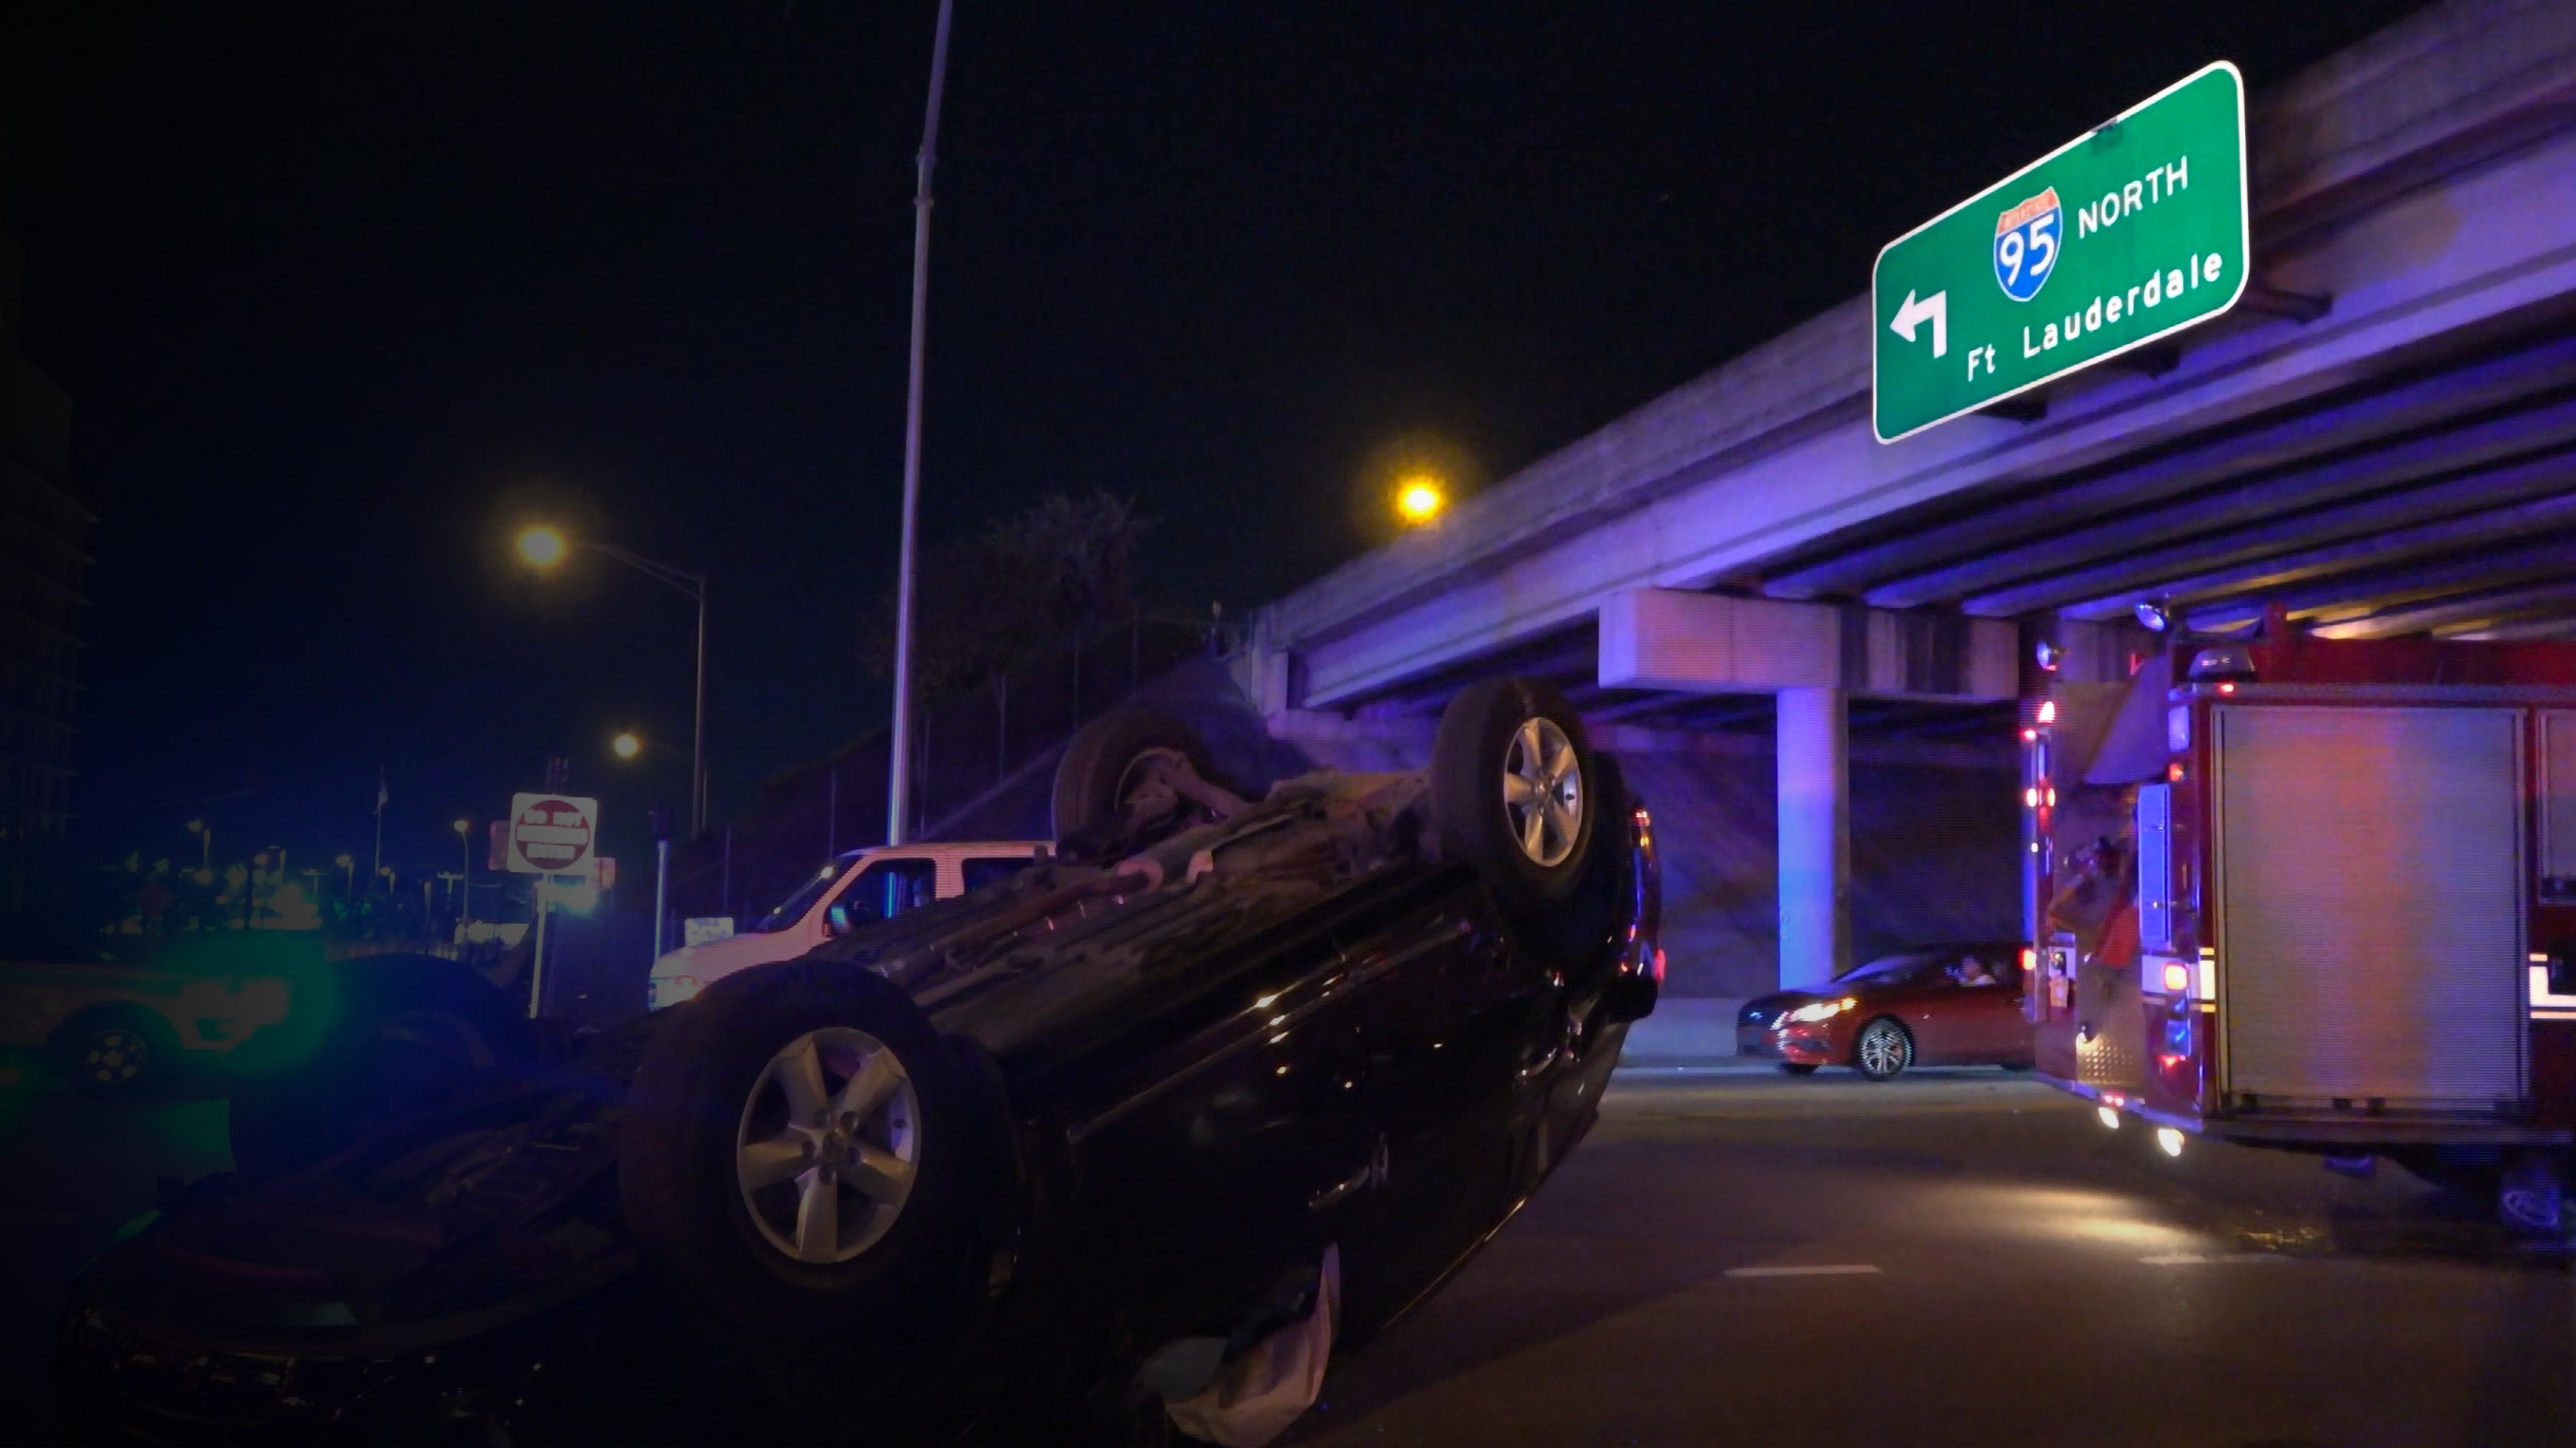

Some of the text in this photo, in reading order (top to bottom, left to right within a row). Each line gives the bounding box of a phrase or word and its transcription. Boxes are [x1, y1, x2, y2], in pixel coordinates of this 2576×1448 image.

[1999, 214, 2055, 287] 95
[2078, 156, 2188, 239] NORTH
[1967, 252, 2223, 382] Ft Lauderdale
